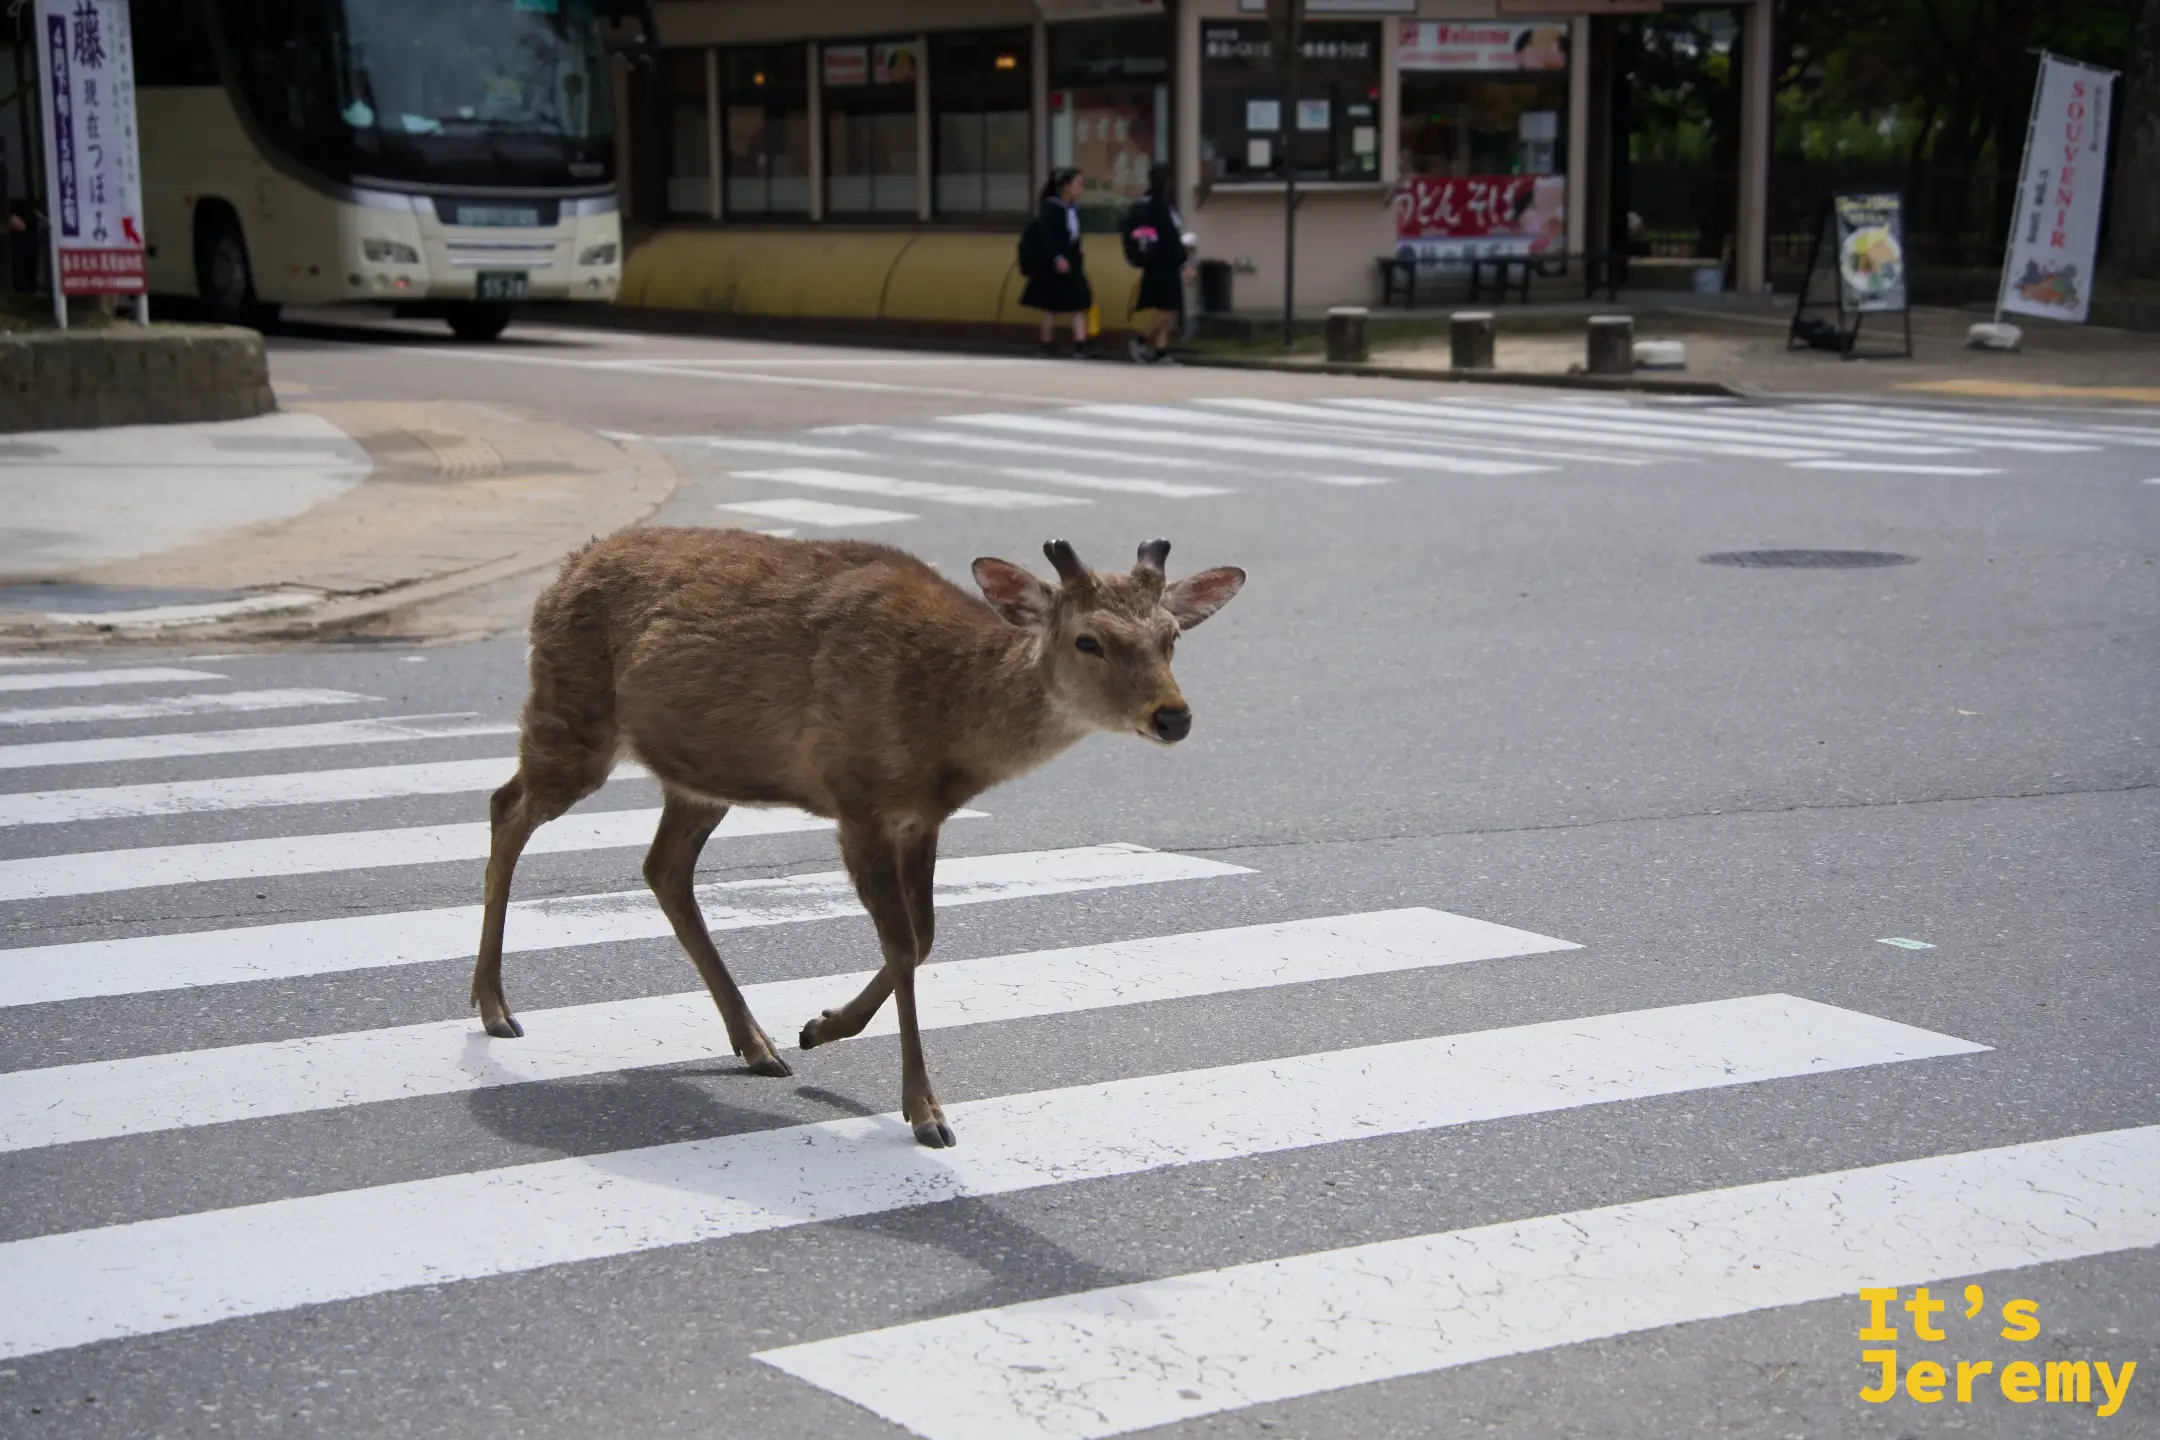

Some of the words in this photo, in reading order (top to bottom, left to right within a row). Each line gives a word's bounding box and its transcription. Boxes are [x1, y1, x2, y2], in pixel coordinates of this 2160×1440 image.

[1393, 179, 1463, 227] うどん
[1467, 179, 1523, 228] そば
[2050, 80, 2085, 249] SOUVENIR
